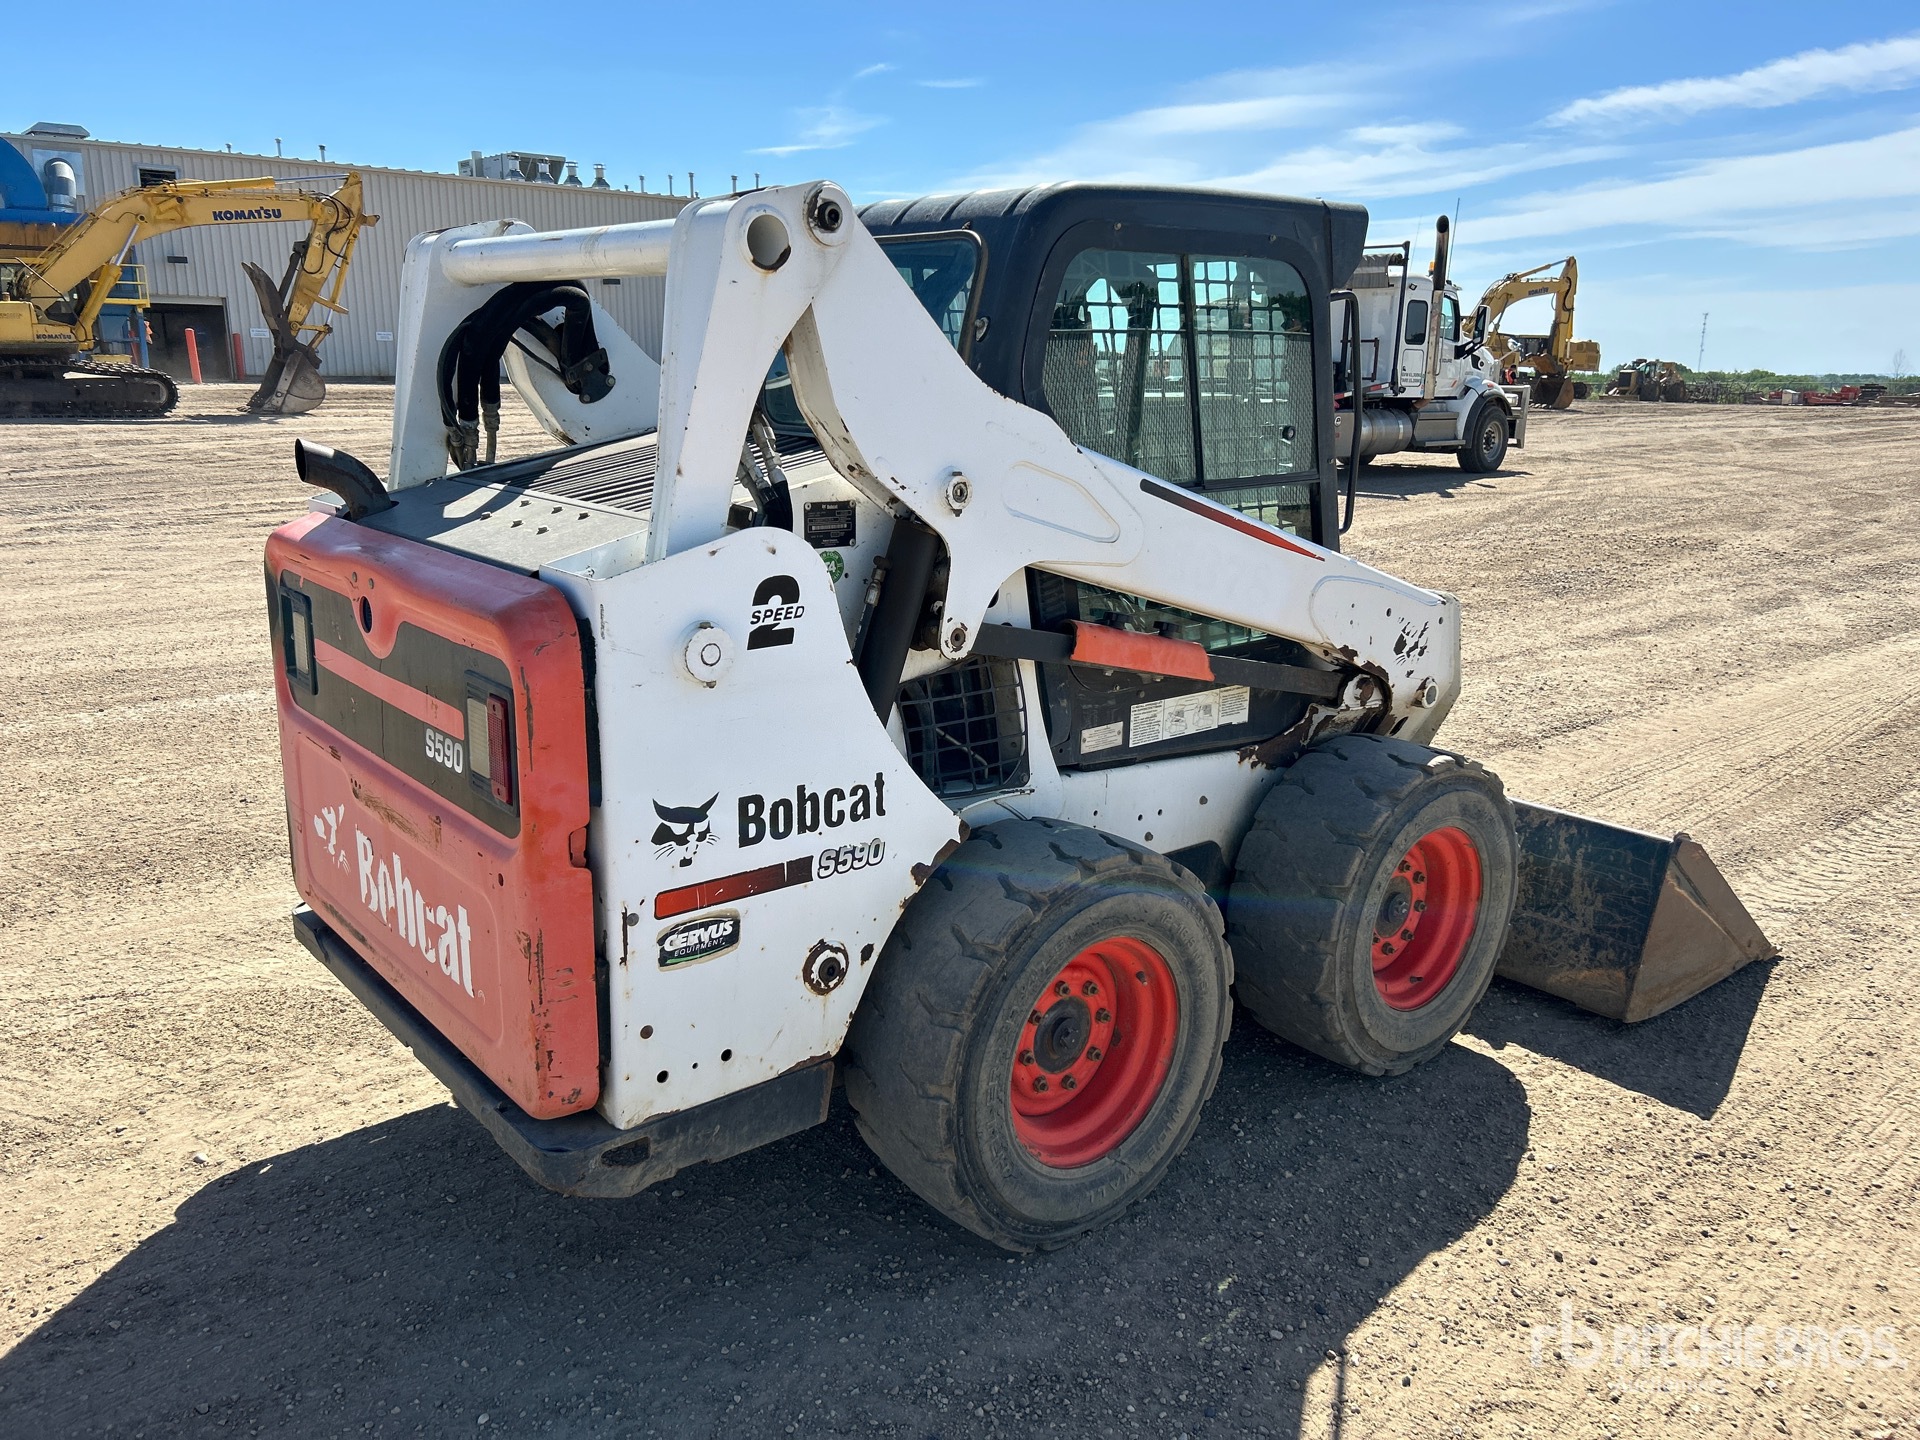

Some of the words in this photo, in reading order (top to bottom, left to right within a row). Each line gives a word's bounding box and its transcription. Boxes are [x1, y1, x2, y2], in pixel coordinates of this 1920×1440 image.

[212, 206, 282, 221] KOMATSU
[747, 574, 801, 651] 2
[750, 605, 805, 625] SPEED
[425, 728, 464, 774] S590
[738, 771, 887, 849] Bobcat
[816, 836, 886, 880] S590
[355, 824, 475, 999] Bobcat
[663, 919, 735, 952] CERVUS
[674, 937, 725, 957] EQUIPMENT
